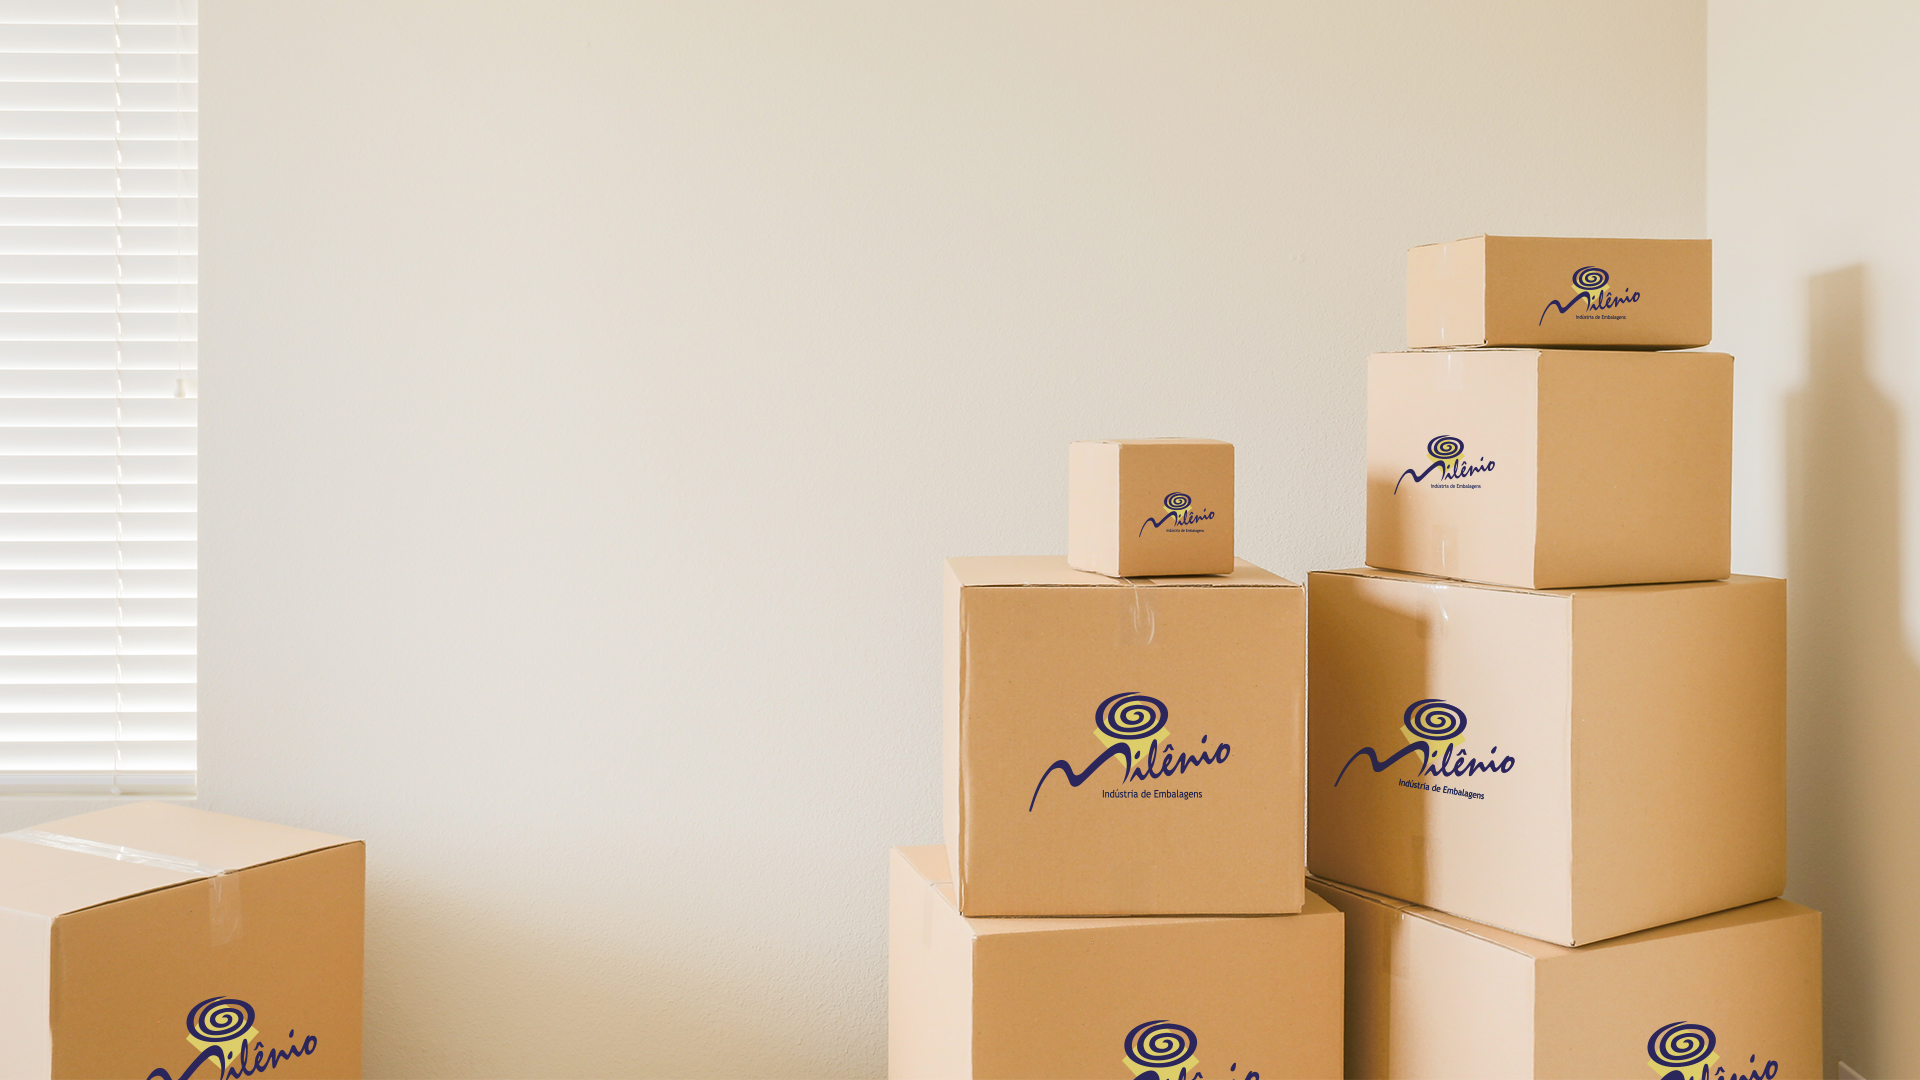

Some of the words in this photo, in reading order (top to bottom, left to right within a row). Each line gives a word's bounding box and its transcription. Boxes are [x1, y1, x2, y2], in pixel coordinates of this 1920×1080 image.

[1539, 287, 1640, 326] Milênio
[1393, 456, 1496, 496] Milênio
[1138, 507, 1215, 538] Milênio
[1028, 734, 1231, 812] Milênio
[1334, 740, 1516, 787] Milênio
[1102, 788, 1139, 799] Indústria
[1140, 789, 1152, 799] de
[1153, 789, 1203, 800] Embalagens
[1398, 778, 1430, 791] Indústria
[1431, 783, 1442, 793] de
[1442, 785, 1485, 800] Embalagens
